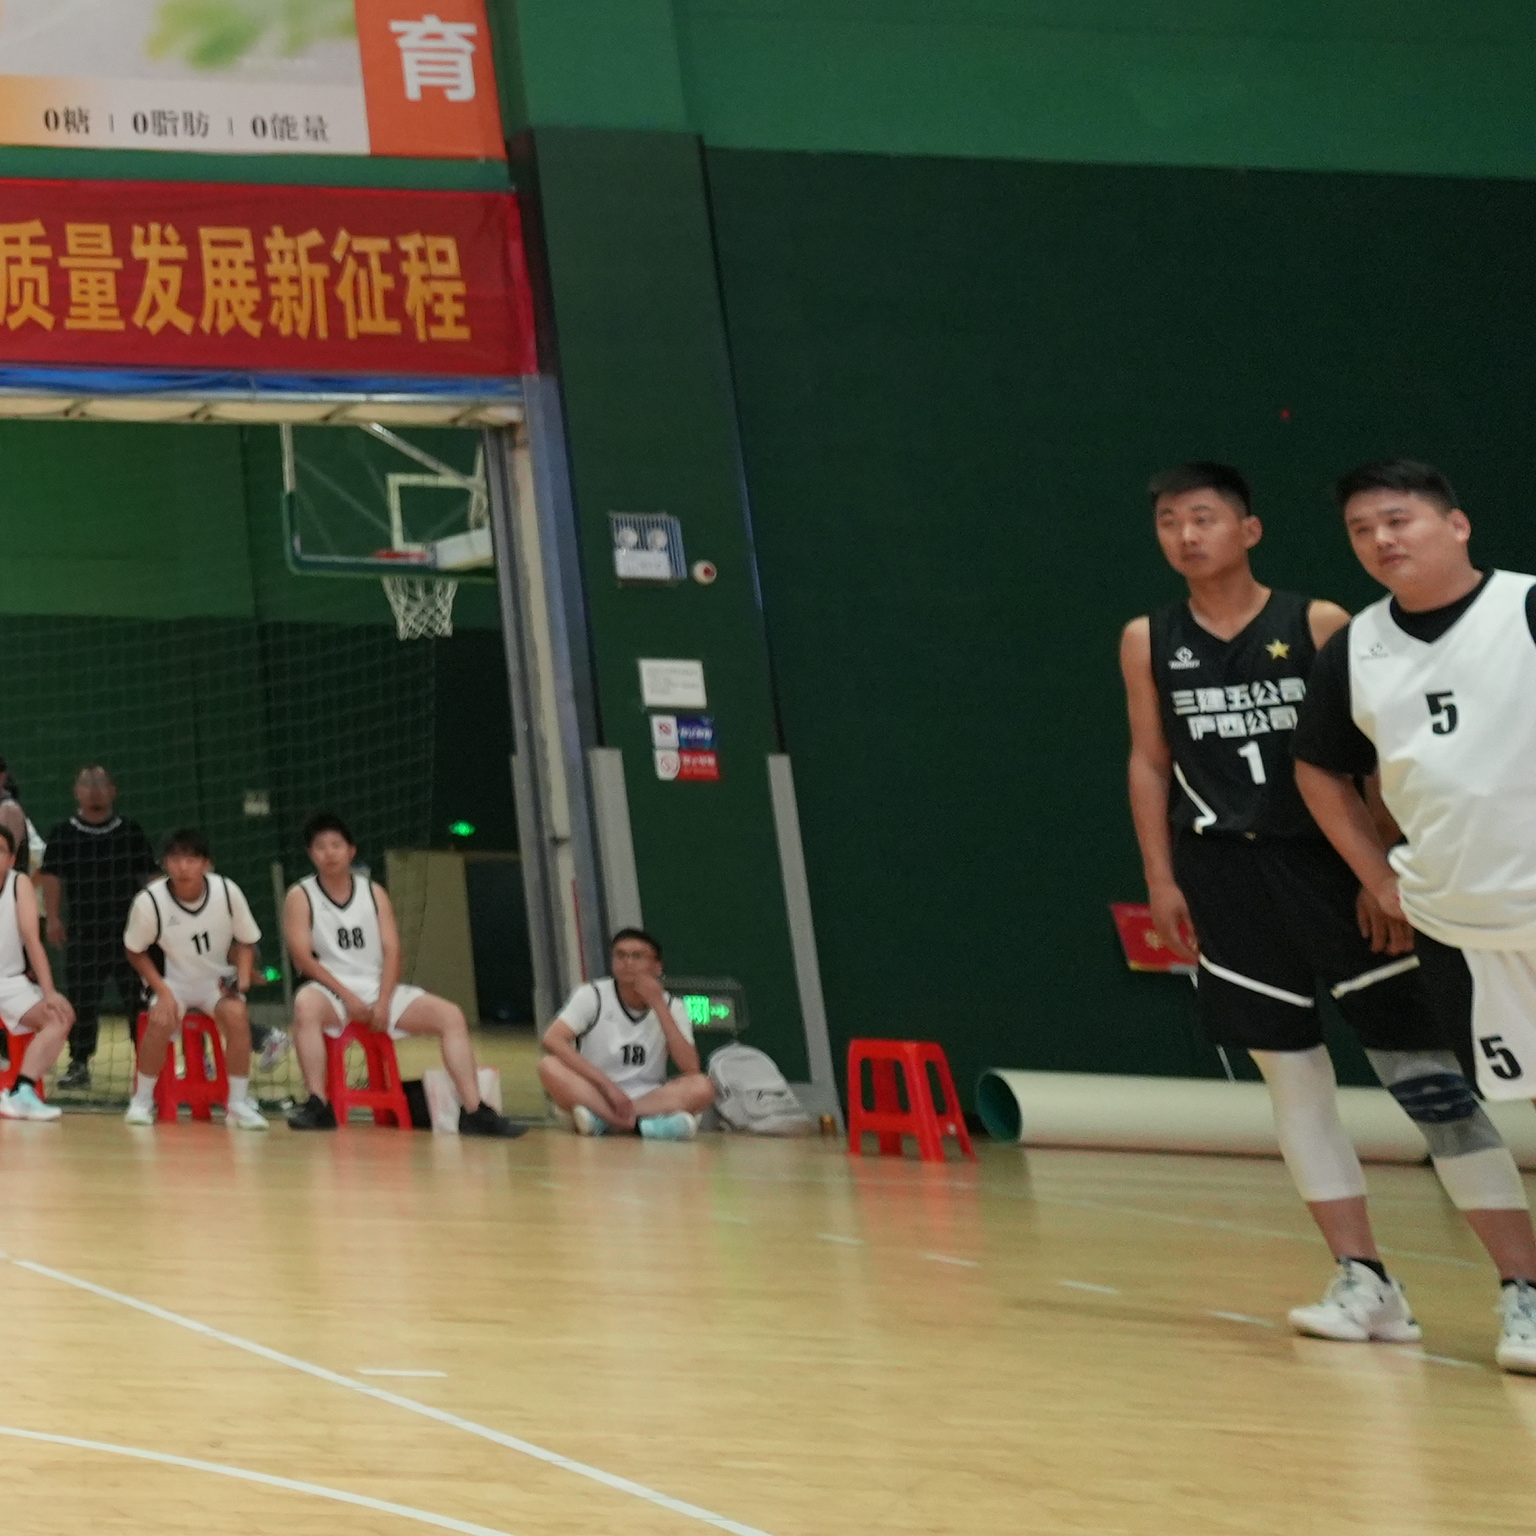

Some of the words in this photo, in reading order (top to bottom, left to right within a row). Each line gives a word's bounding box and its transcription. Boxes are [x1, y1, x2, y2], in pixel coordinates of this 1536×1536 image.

[43, 106, 90, 135] 0糖
[132, 109, 209, 139] 0脂肪
[252, 114, 329, 143] 0能量
[1425, 690, 1461, 737] 5
[1237, 740, 1267, 785] 1
[191, 931, 211, 956] 11
[336, 927, 367, 950] 88
[1479, 1036, 1523, 1080] 5
